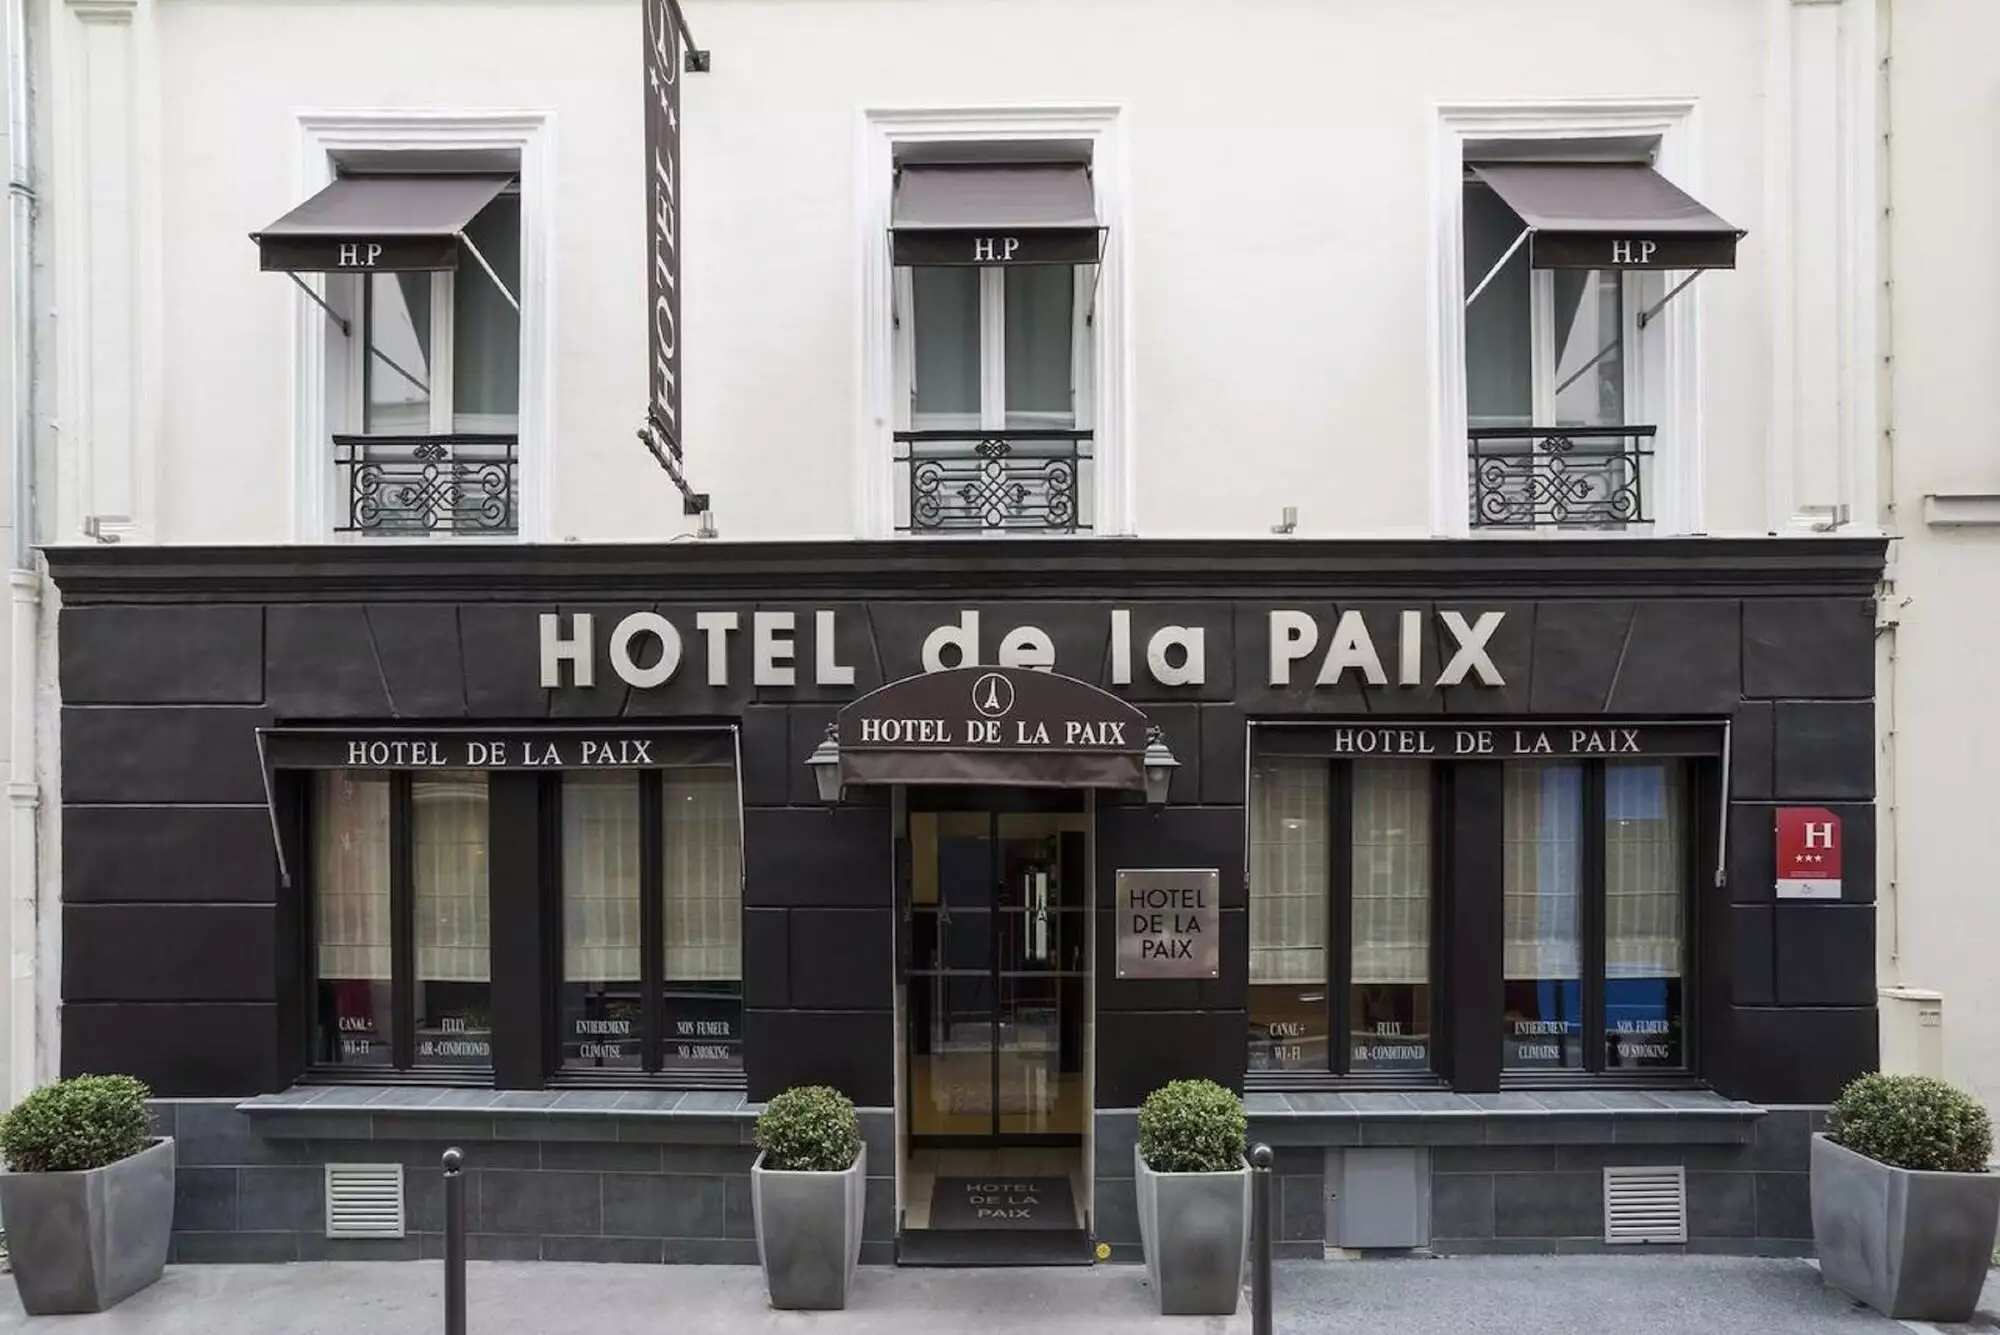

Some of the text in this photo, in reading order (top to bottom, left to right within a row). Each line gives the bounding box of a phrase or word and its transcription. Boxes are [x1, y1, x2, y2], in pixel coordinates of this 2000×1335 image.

[338, 243, 382, 266] H.P
[974, 237, 1019, 260] H.P
[1612, 240, 1656, 263] H.P
[655, 145, 675, 430] HOTEL
[539, 610, 1506, 688] HOTEL de la PAIX
[861, 719, 1126, 745] HOTEL DE LA PAIX
[1334, 729, 1641, 753] HOTEL DE LA PAIX
[348, 740, 653, 765] HOTEL DE LA PAIX
[1804, 822, 1834, 848] H
[1130, 889, 1206, 909] HOTEL
[1133, 914, 1202, 934] DE LA
[1142, 939, 1193, 959] PAIX
[677, 1021, 730, 1036] NON FUMEUR
[678, 1045, 729, 1059] NO SMOKING
[1617, 1044, 1630, 1058] NO
[966, 1184, 1041, 1192] HOTEL
[969, 1196, 1040, 1204] DE LA
[978, 1208, 1031, 1218] PAIX
